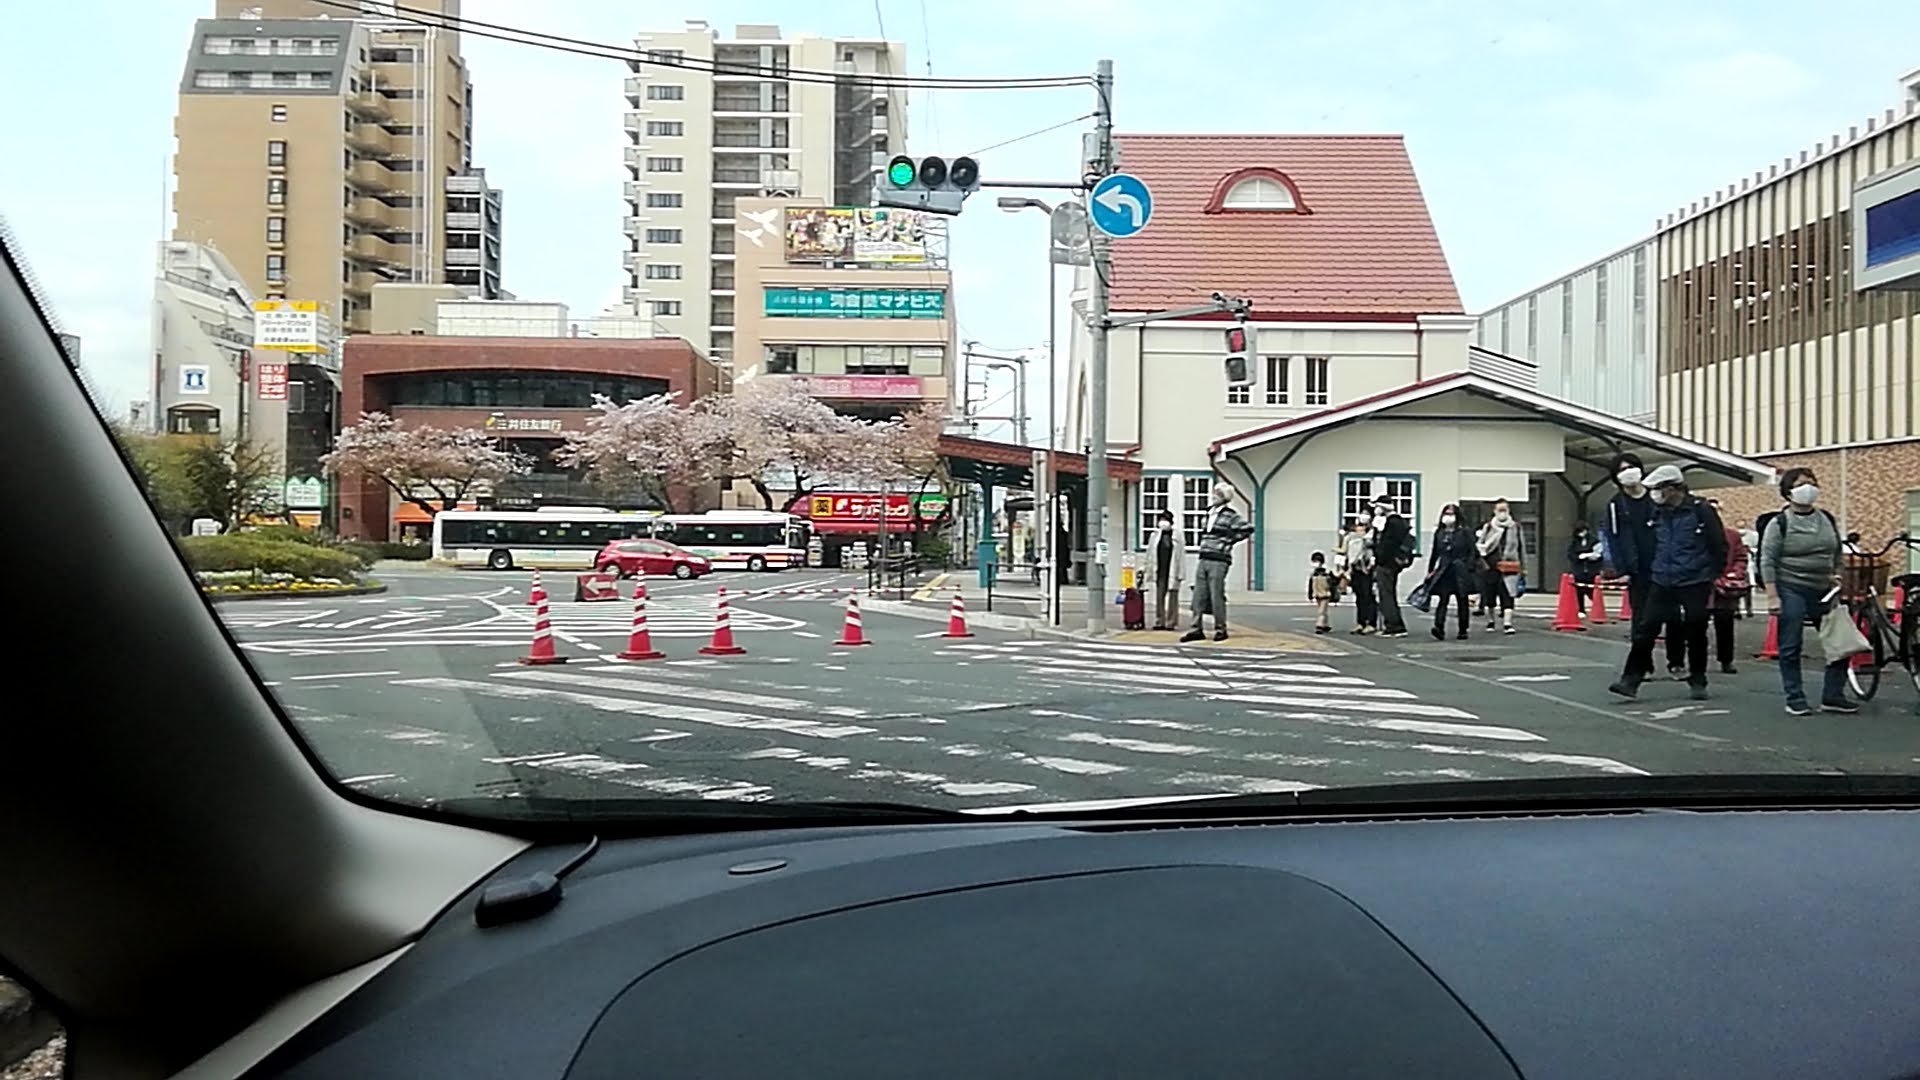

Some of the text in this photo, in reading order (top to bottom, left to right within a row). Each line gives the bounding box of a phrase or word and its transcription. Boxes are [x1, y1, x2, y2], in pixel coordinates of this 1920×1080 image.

[497, 419, 561, 433] 三井住友銀行
